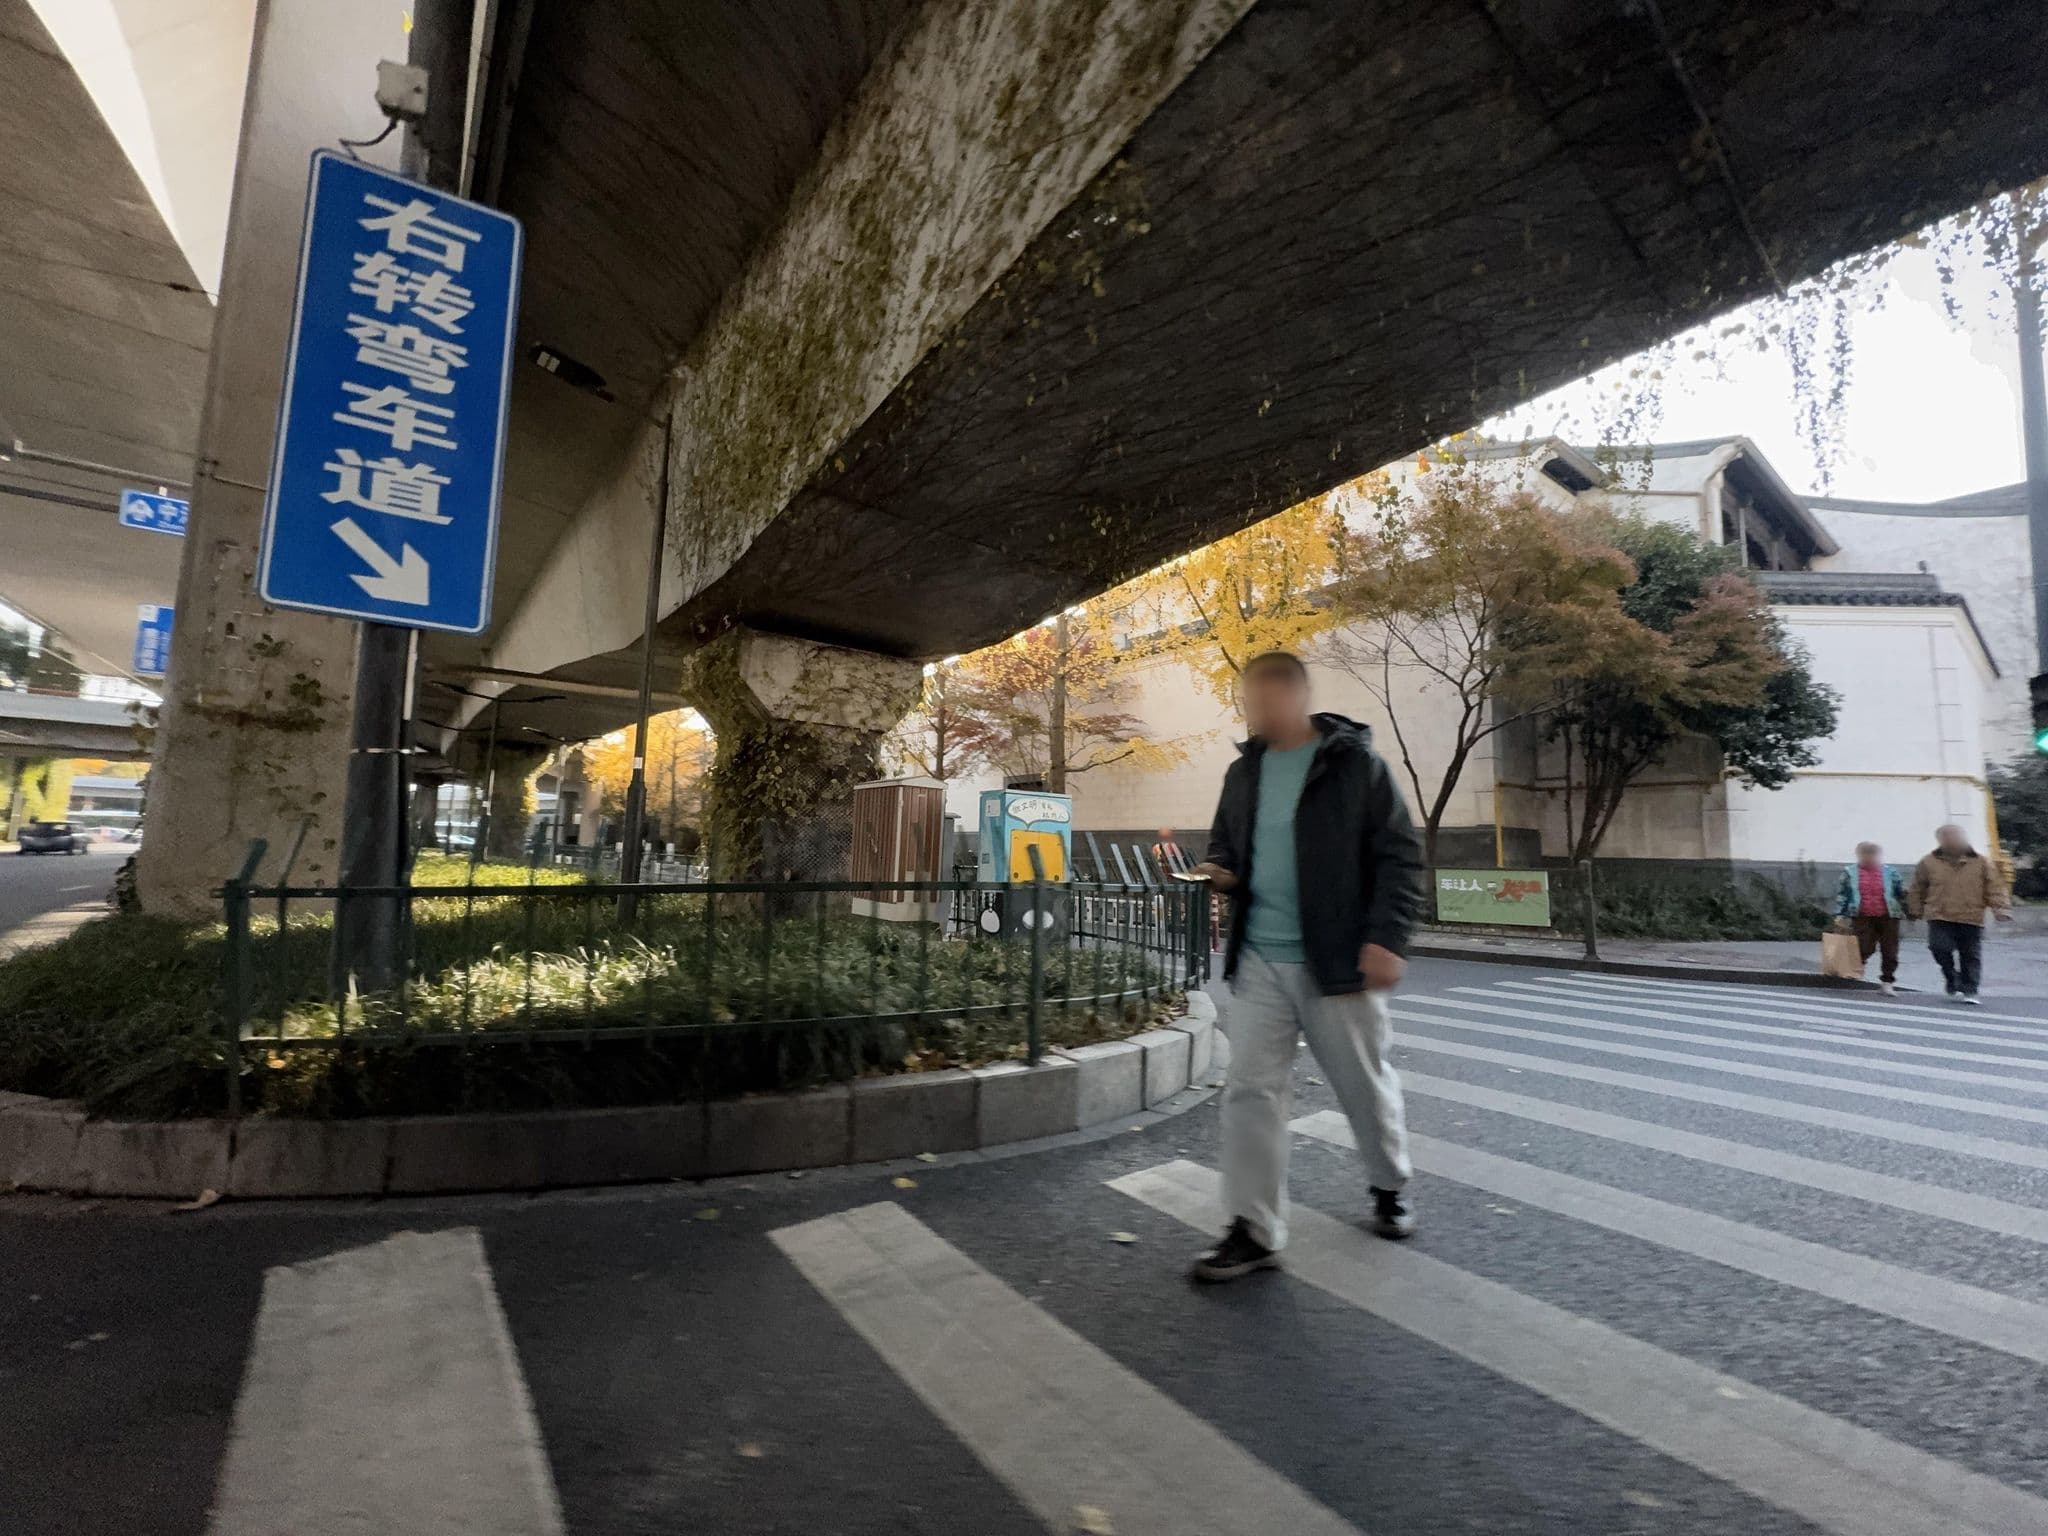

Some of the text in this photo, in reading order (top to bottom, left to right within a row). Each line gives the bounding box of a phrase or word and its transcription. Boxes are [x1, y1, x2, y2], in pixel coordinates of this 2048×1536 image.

[320, 193, 483, 526] 右转弯车道
[1440, 878, 1483, 892] 车让人
